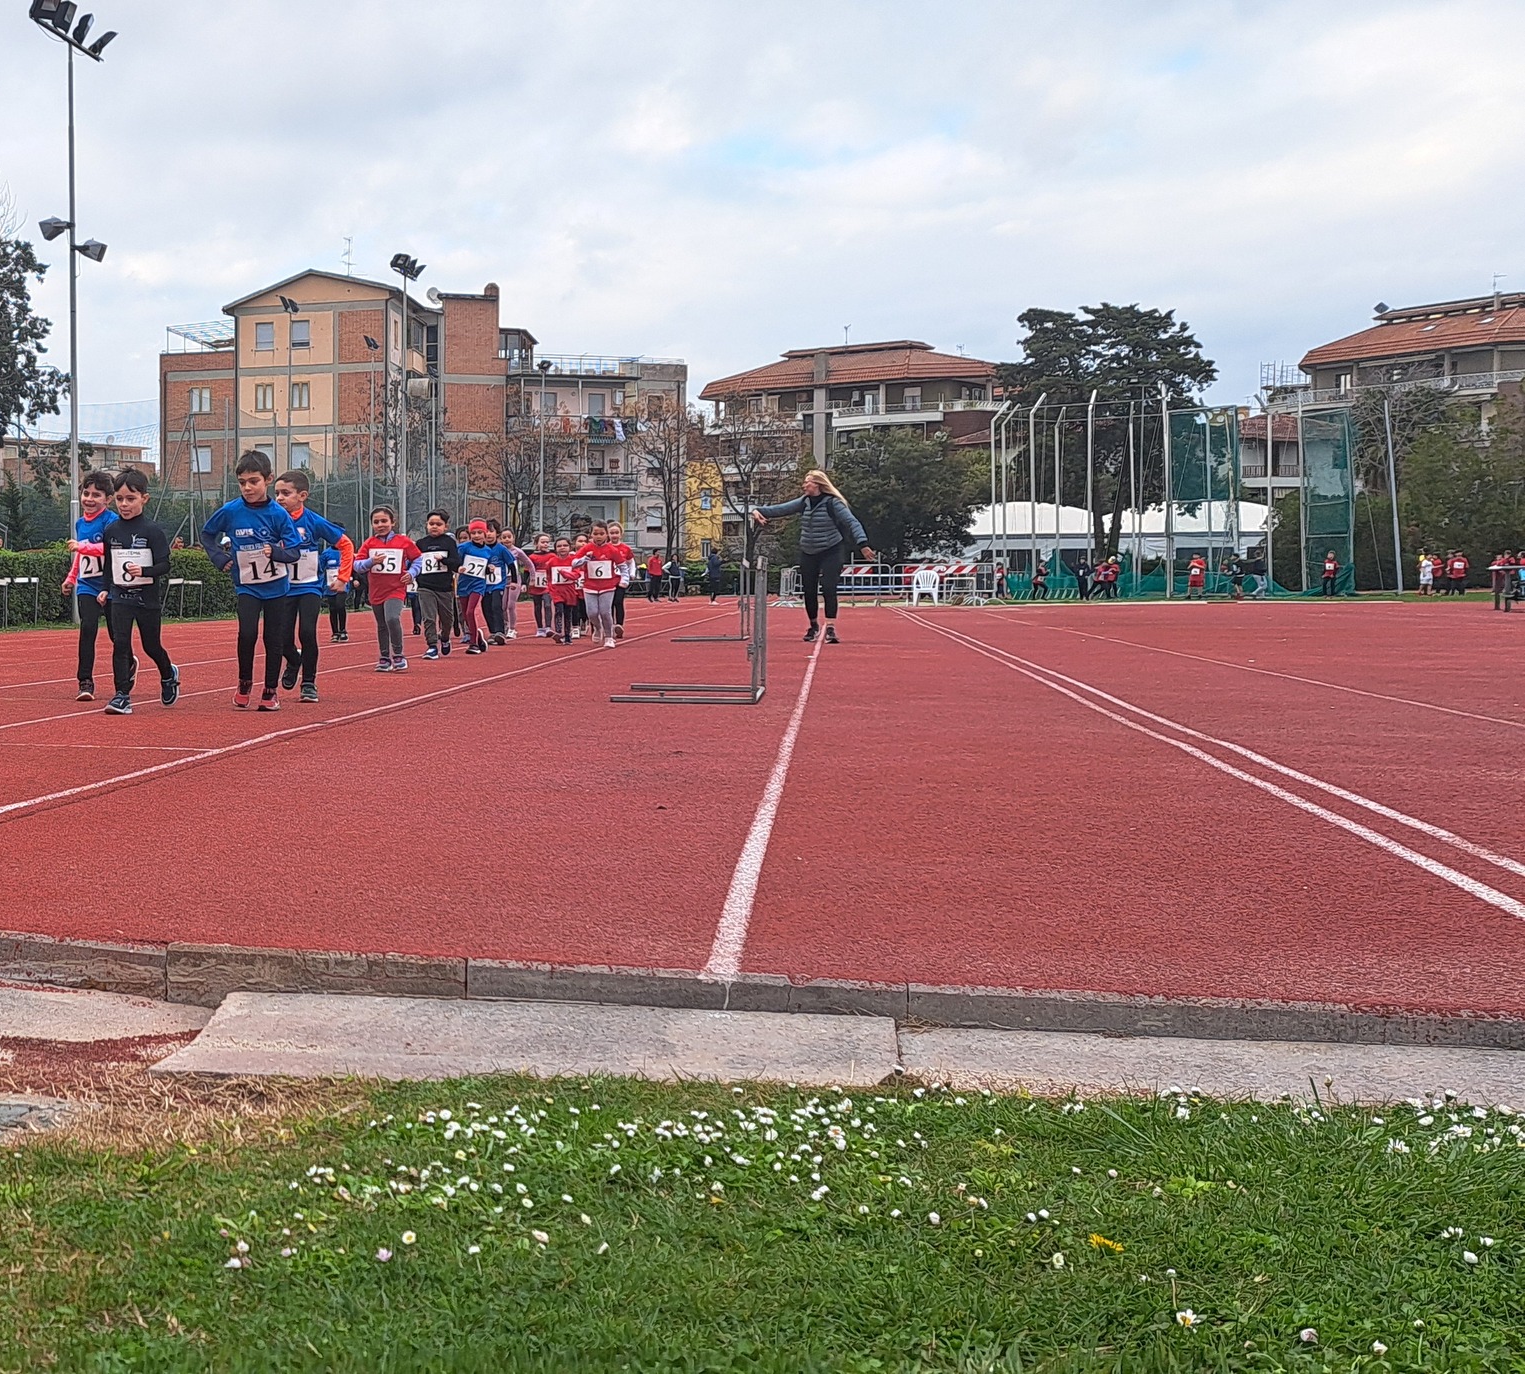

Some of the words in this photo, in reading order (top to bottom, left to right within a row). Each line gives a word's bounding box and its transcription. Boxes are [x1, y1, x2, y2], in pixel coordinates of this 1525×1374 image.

[82, 556, 103, 574] 21
[122, 561, 135, 582] 8
[249, 559, 278, 580] 14
[425, 559, 442, 572] 84
[467, 562, 485, 576] 27
[595, 565, 603, 577] 6
[536, 576, 547, 586] 18
